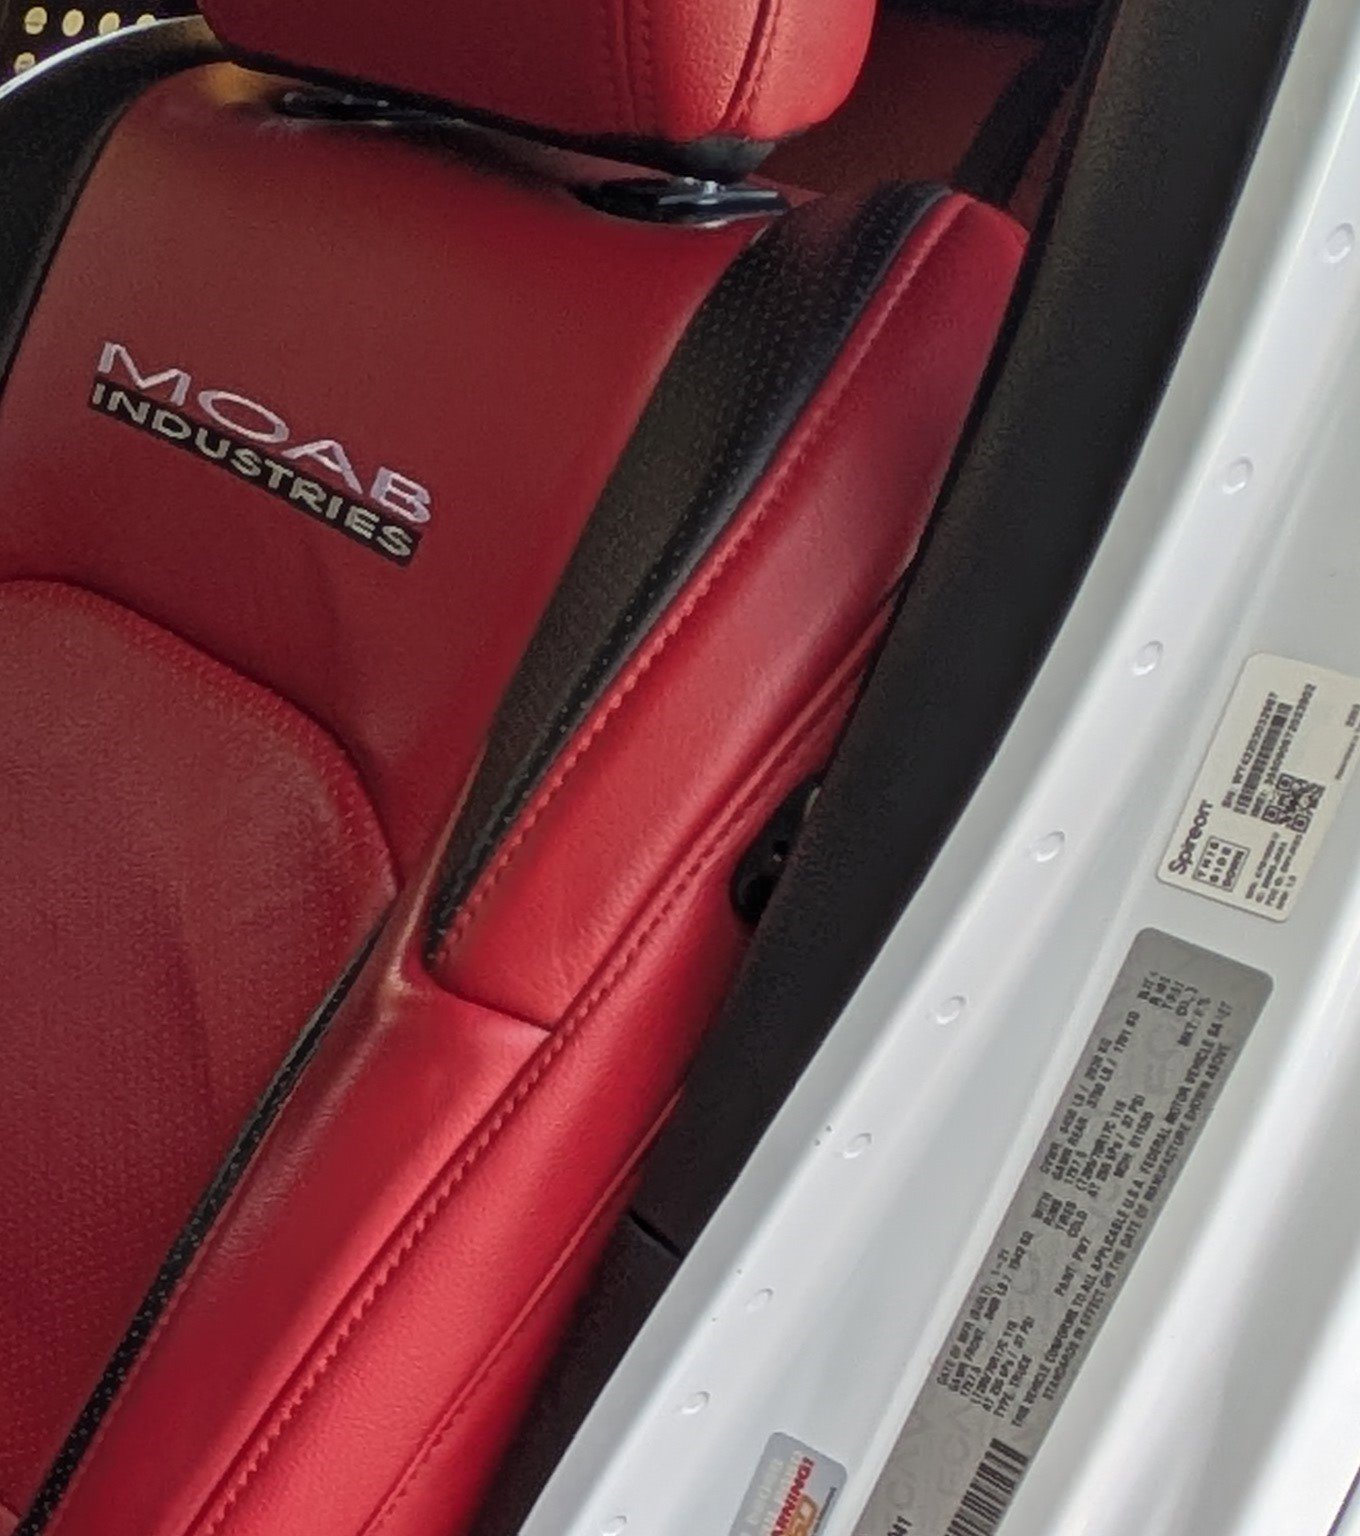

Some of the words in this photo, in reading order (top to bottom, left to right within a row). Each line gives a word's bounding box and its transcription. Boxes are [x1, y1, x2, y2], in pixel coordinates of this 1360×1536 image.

[91, 382, 414, 558] INDUSTRIES
[97, 341, 431, 524] MOAB
[1168, 799, 1213, 876] Spireon
[1137, 1123, 1173, 1176] FEDERAL
[1162, 1083, 1192, 1125] MOTOR
[1181, 1036, 1215, 1086] VEHICLE
